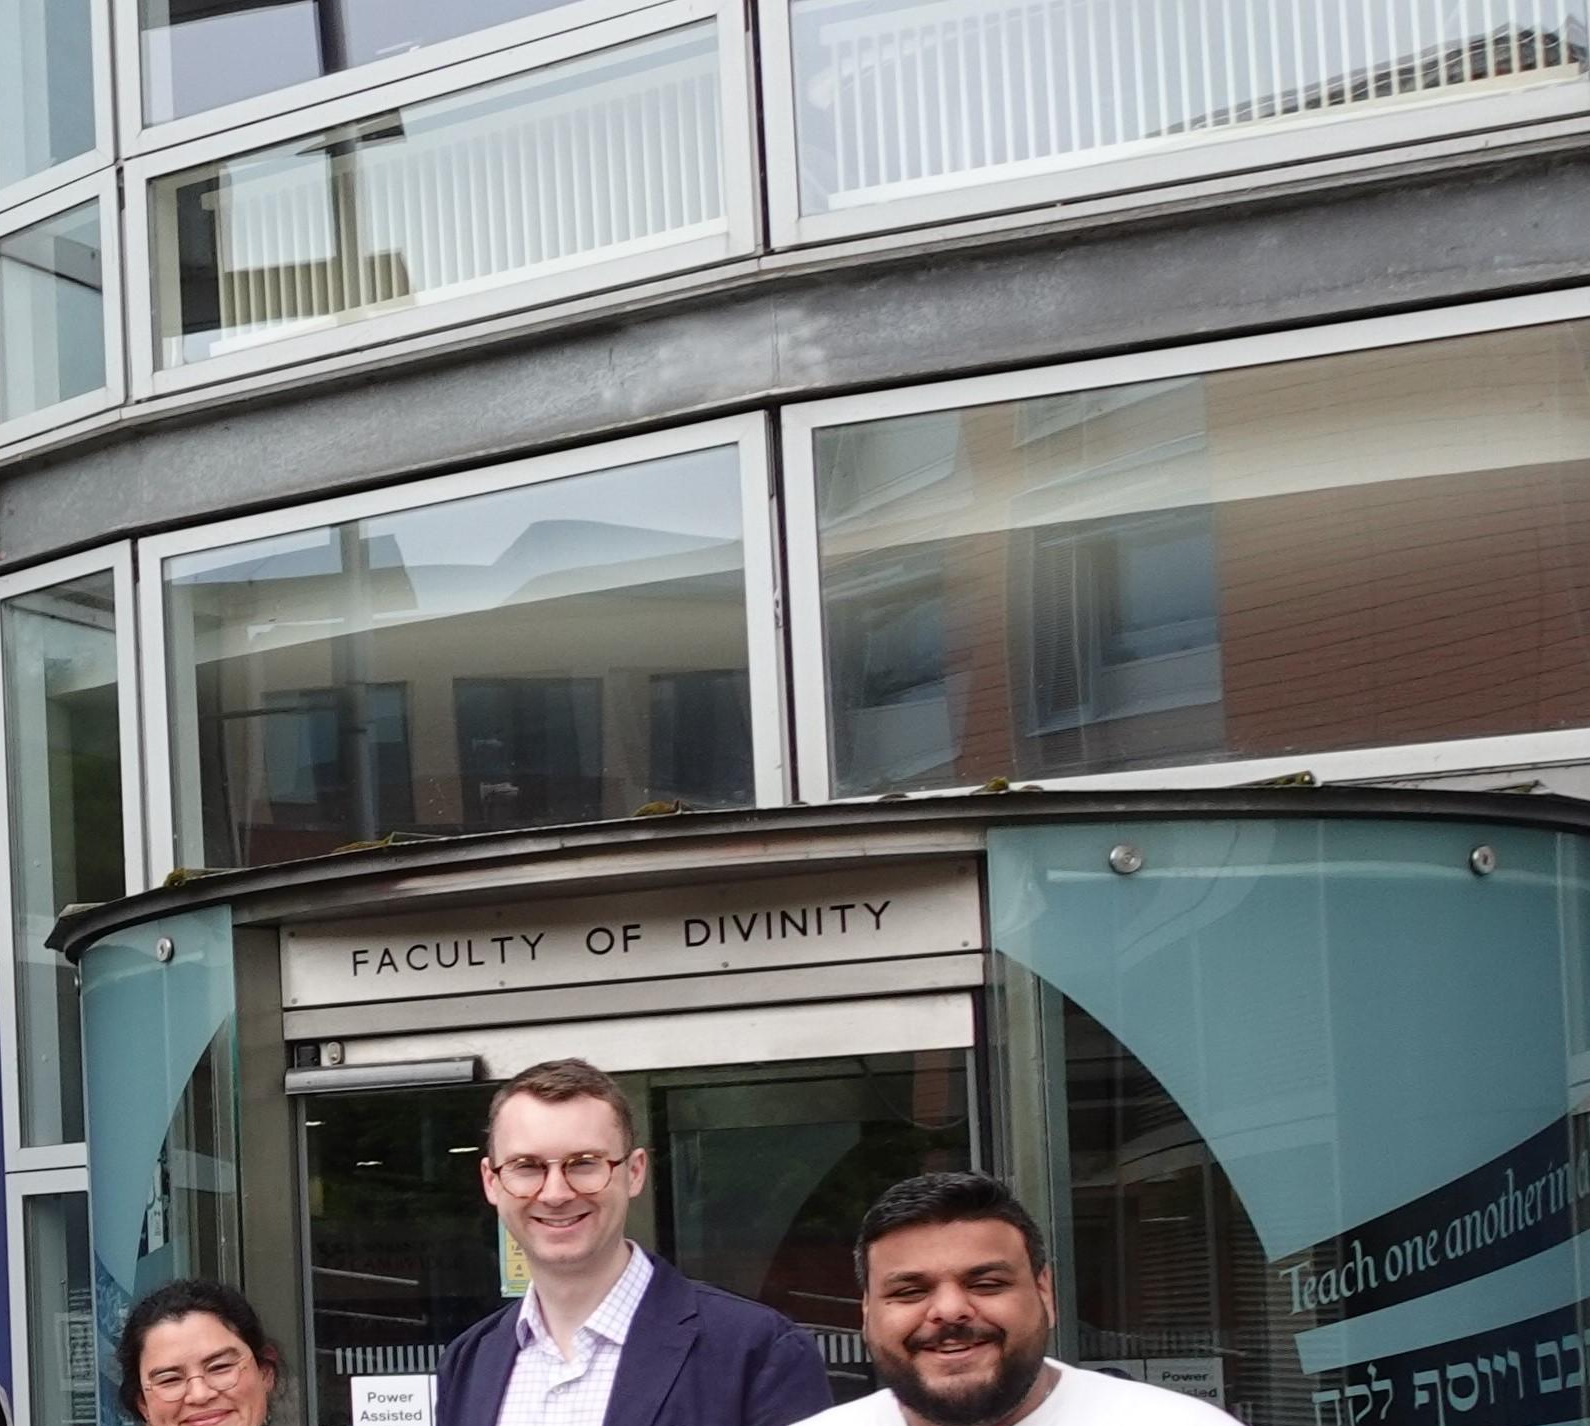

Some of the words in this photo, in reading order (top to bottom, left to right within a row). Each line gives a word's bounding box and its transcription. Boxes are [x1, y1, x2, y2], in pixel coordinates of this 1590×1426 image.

[351, 932, 545, 977] FACULTY
[585, 923, 643, 956] OF
[683, 900, 893, 948] DIVINITY
[1278, 1239, 1379, 1315] Teach
[1383, 1228, 1440, 1283] one
[1444, 1168, 1547, 1260] another
[1162, 1371, 1209, 1382] Power
[1535, 1333, 1590, 1395] כם
[360, 1408, 423, 1422] Assisted
[367, 1391, 414, 1404] Power
